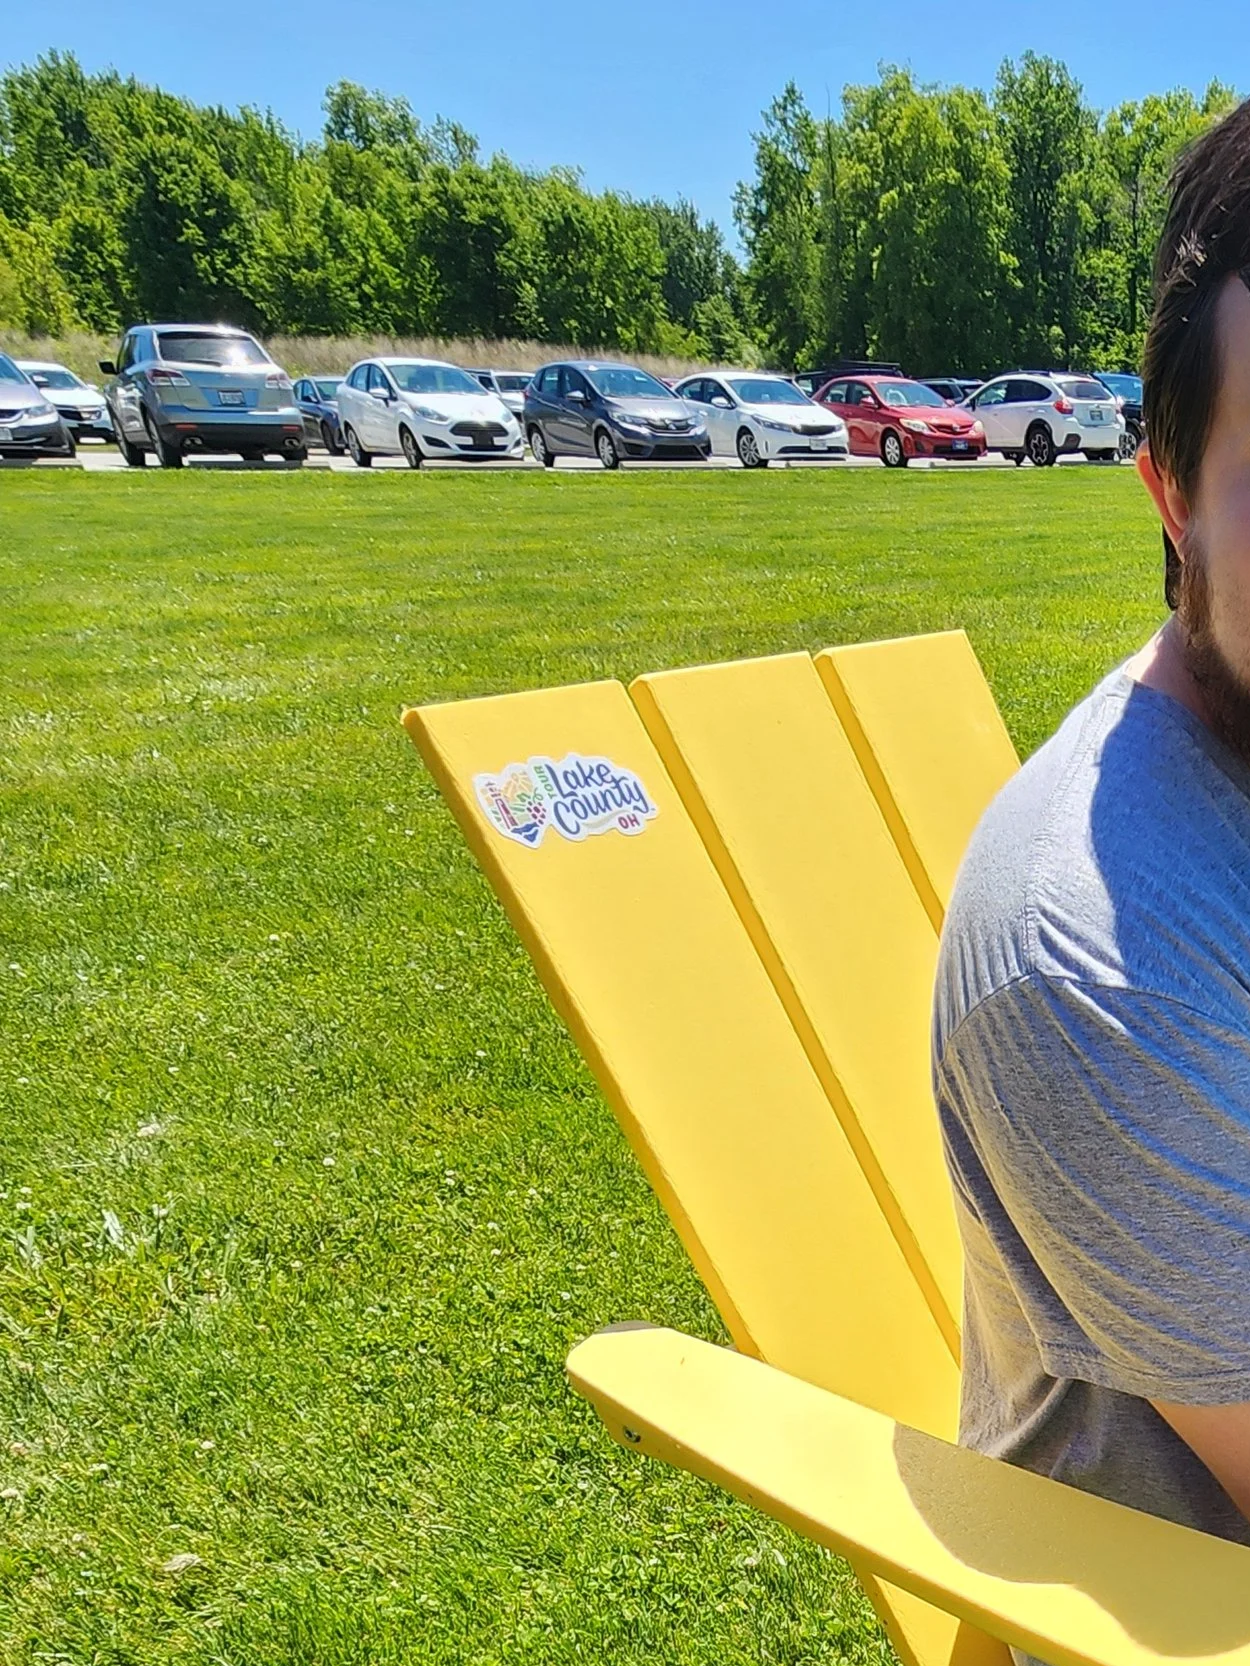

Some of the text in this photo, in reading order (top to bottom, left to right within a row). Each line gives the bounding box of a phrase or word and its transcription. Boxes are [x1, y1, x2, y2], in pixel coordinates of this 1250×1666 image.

[533, 765, 557, 800] TOUR
[544, 760, 614, 799] Lake
[553, 776, 649, 835] County
[617, 813, 641, 830] OH
